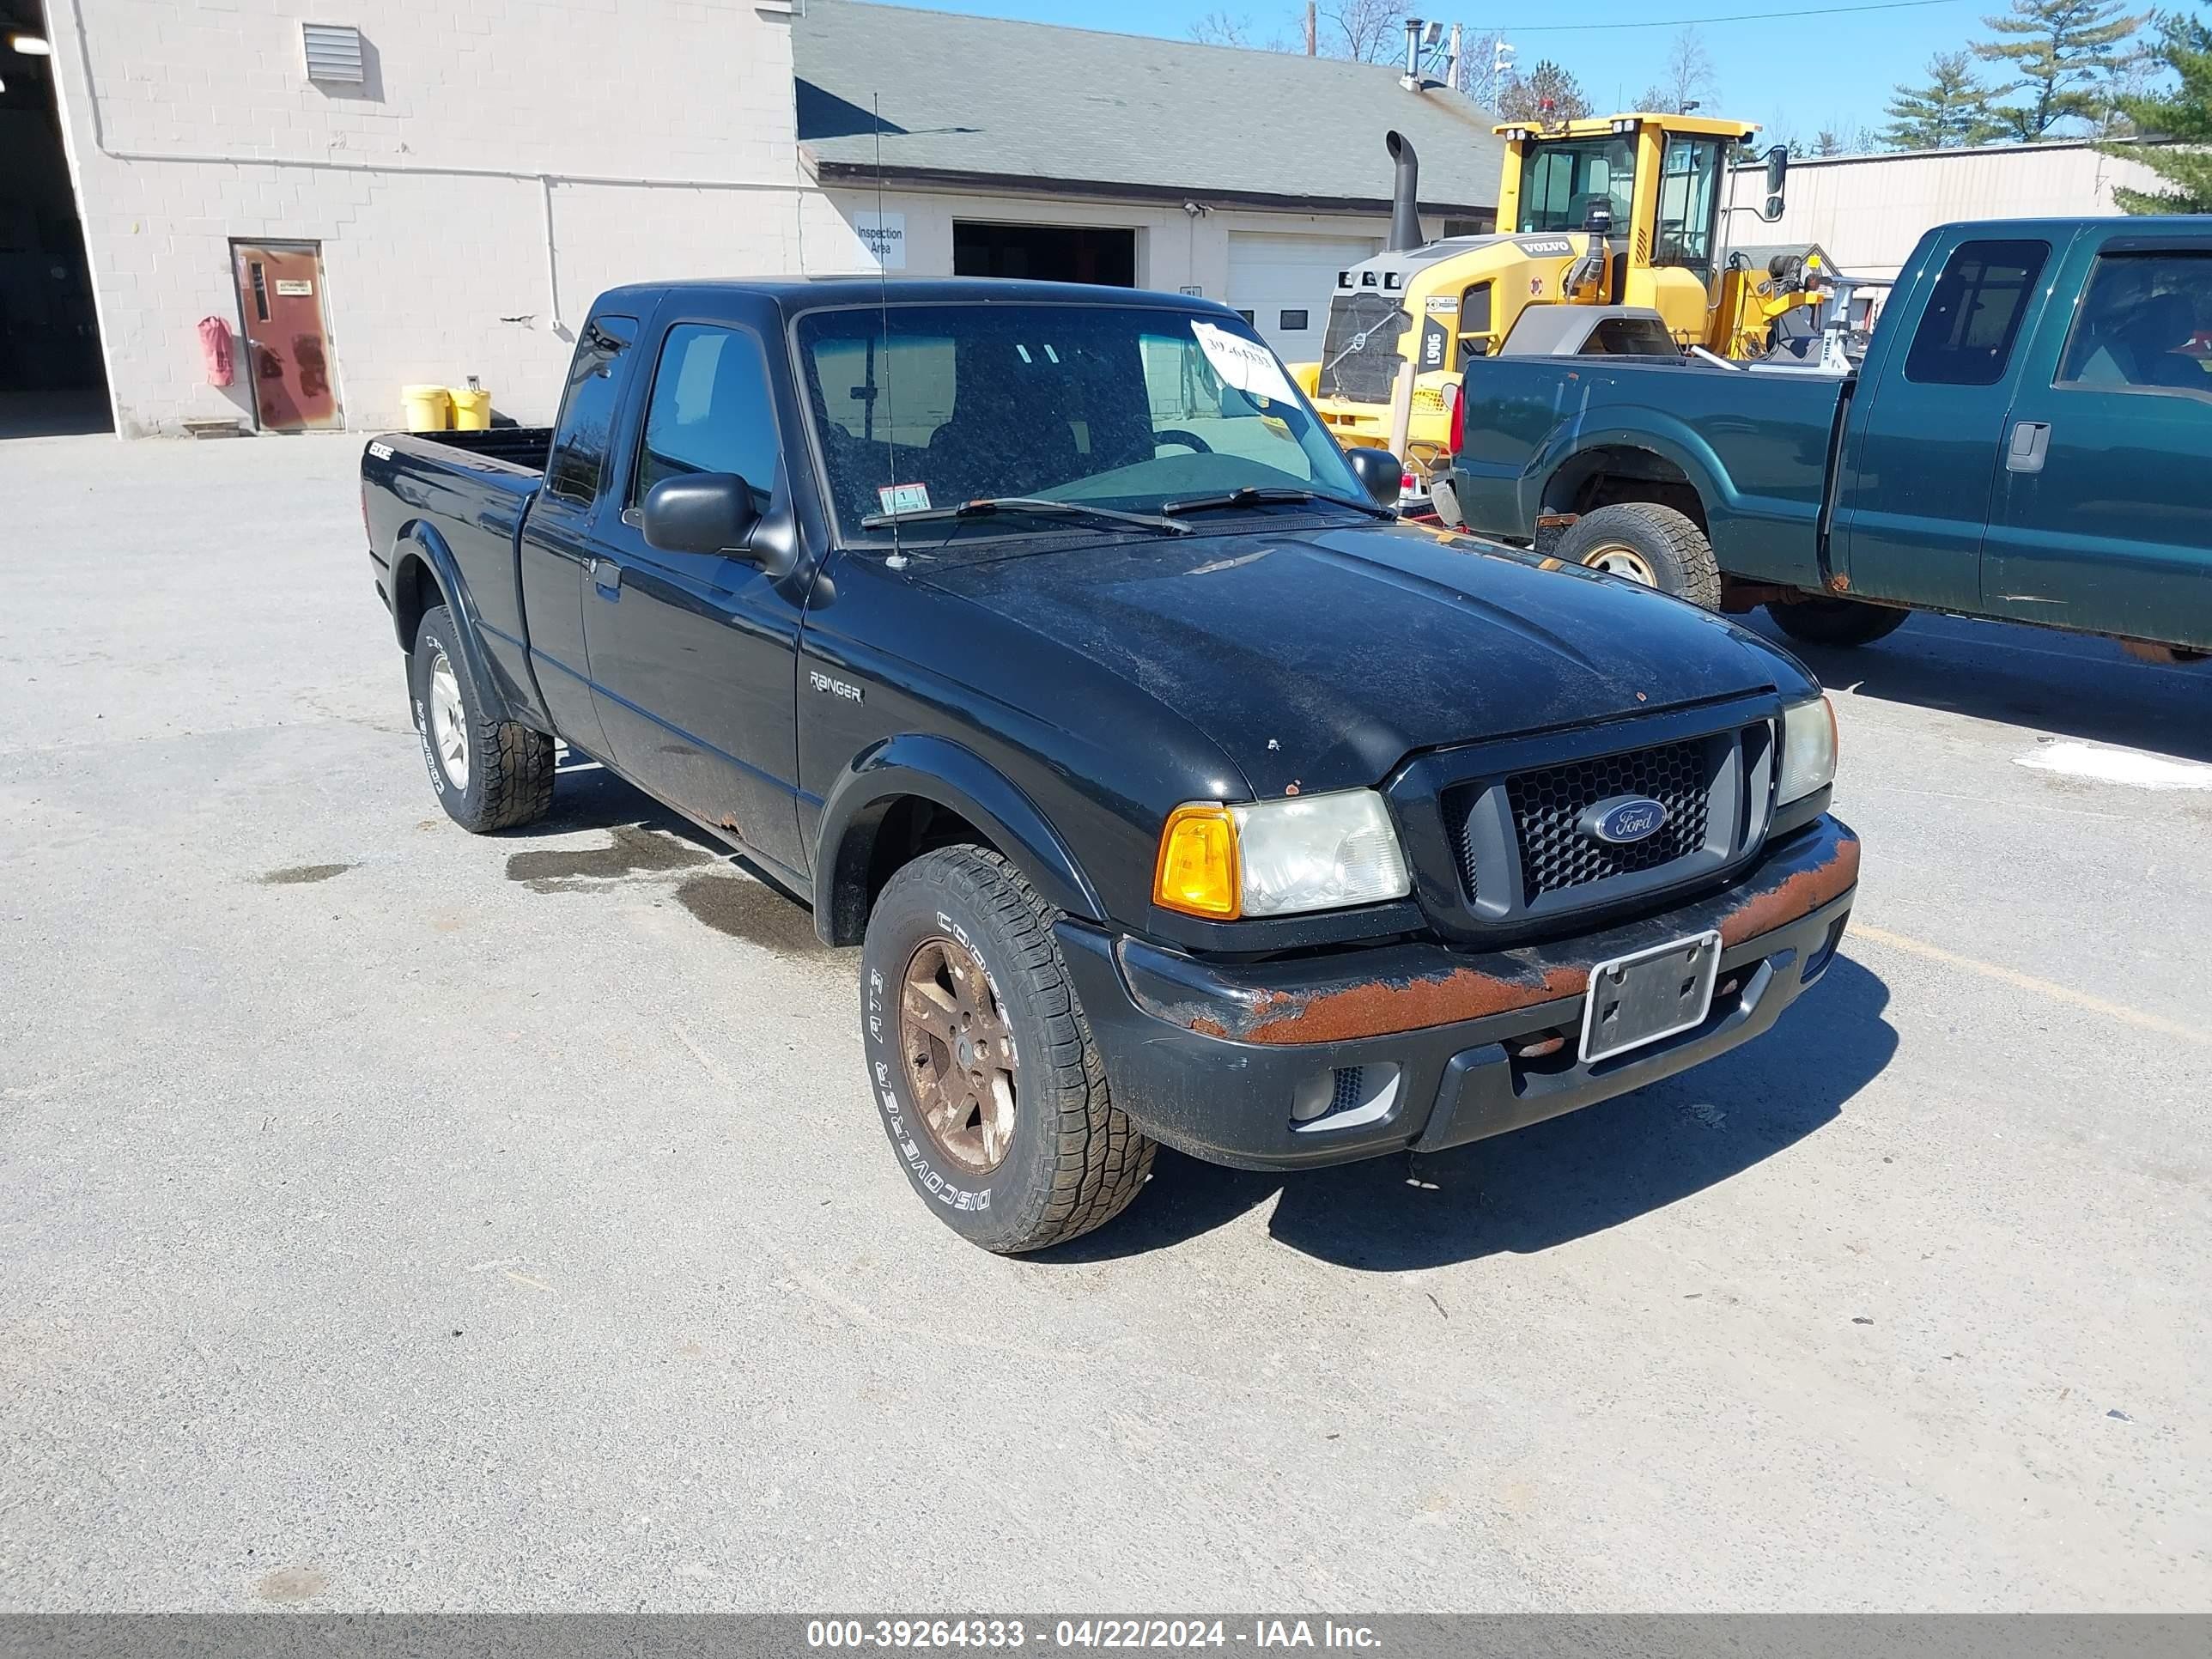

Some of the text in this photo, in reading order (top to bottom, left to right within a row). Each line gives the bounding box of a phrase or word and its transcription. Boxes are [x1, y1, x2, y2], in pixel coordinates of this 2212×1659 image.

[857, 226, 902, 240] Inspection
[1521, 240, 1569, 252] VOLVO
[871, 240, 891, 254] Area
[1426, 333, 1442, 365] L90G
[1823, 336, 1832, 362] THULE
[368, 441, 395, 461] EDGE
[899, 491, 907, 501] 1
[810, 671, 861, 702] RANGER
[416, 698, 445, 795] COOPER
[1615, 808, 1654, 836] Ford
[937, 911, 1020, 1069] COOPER
[868, 968, 992, 1211] DISCOVERER AT3
